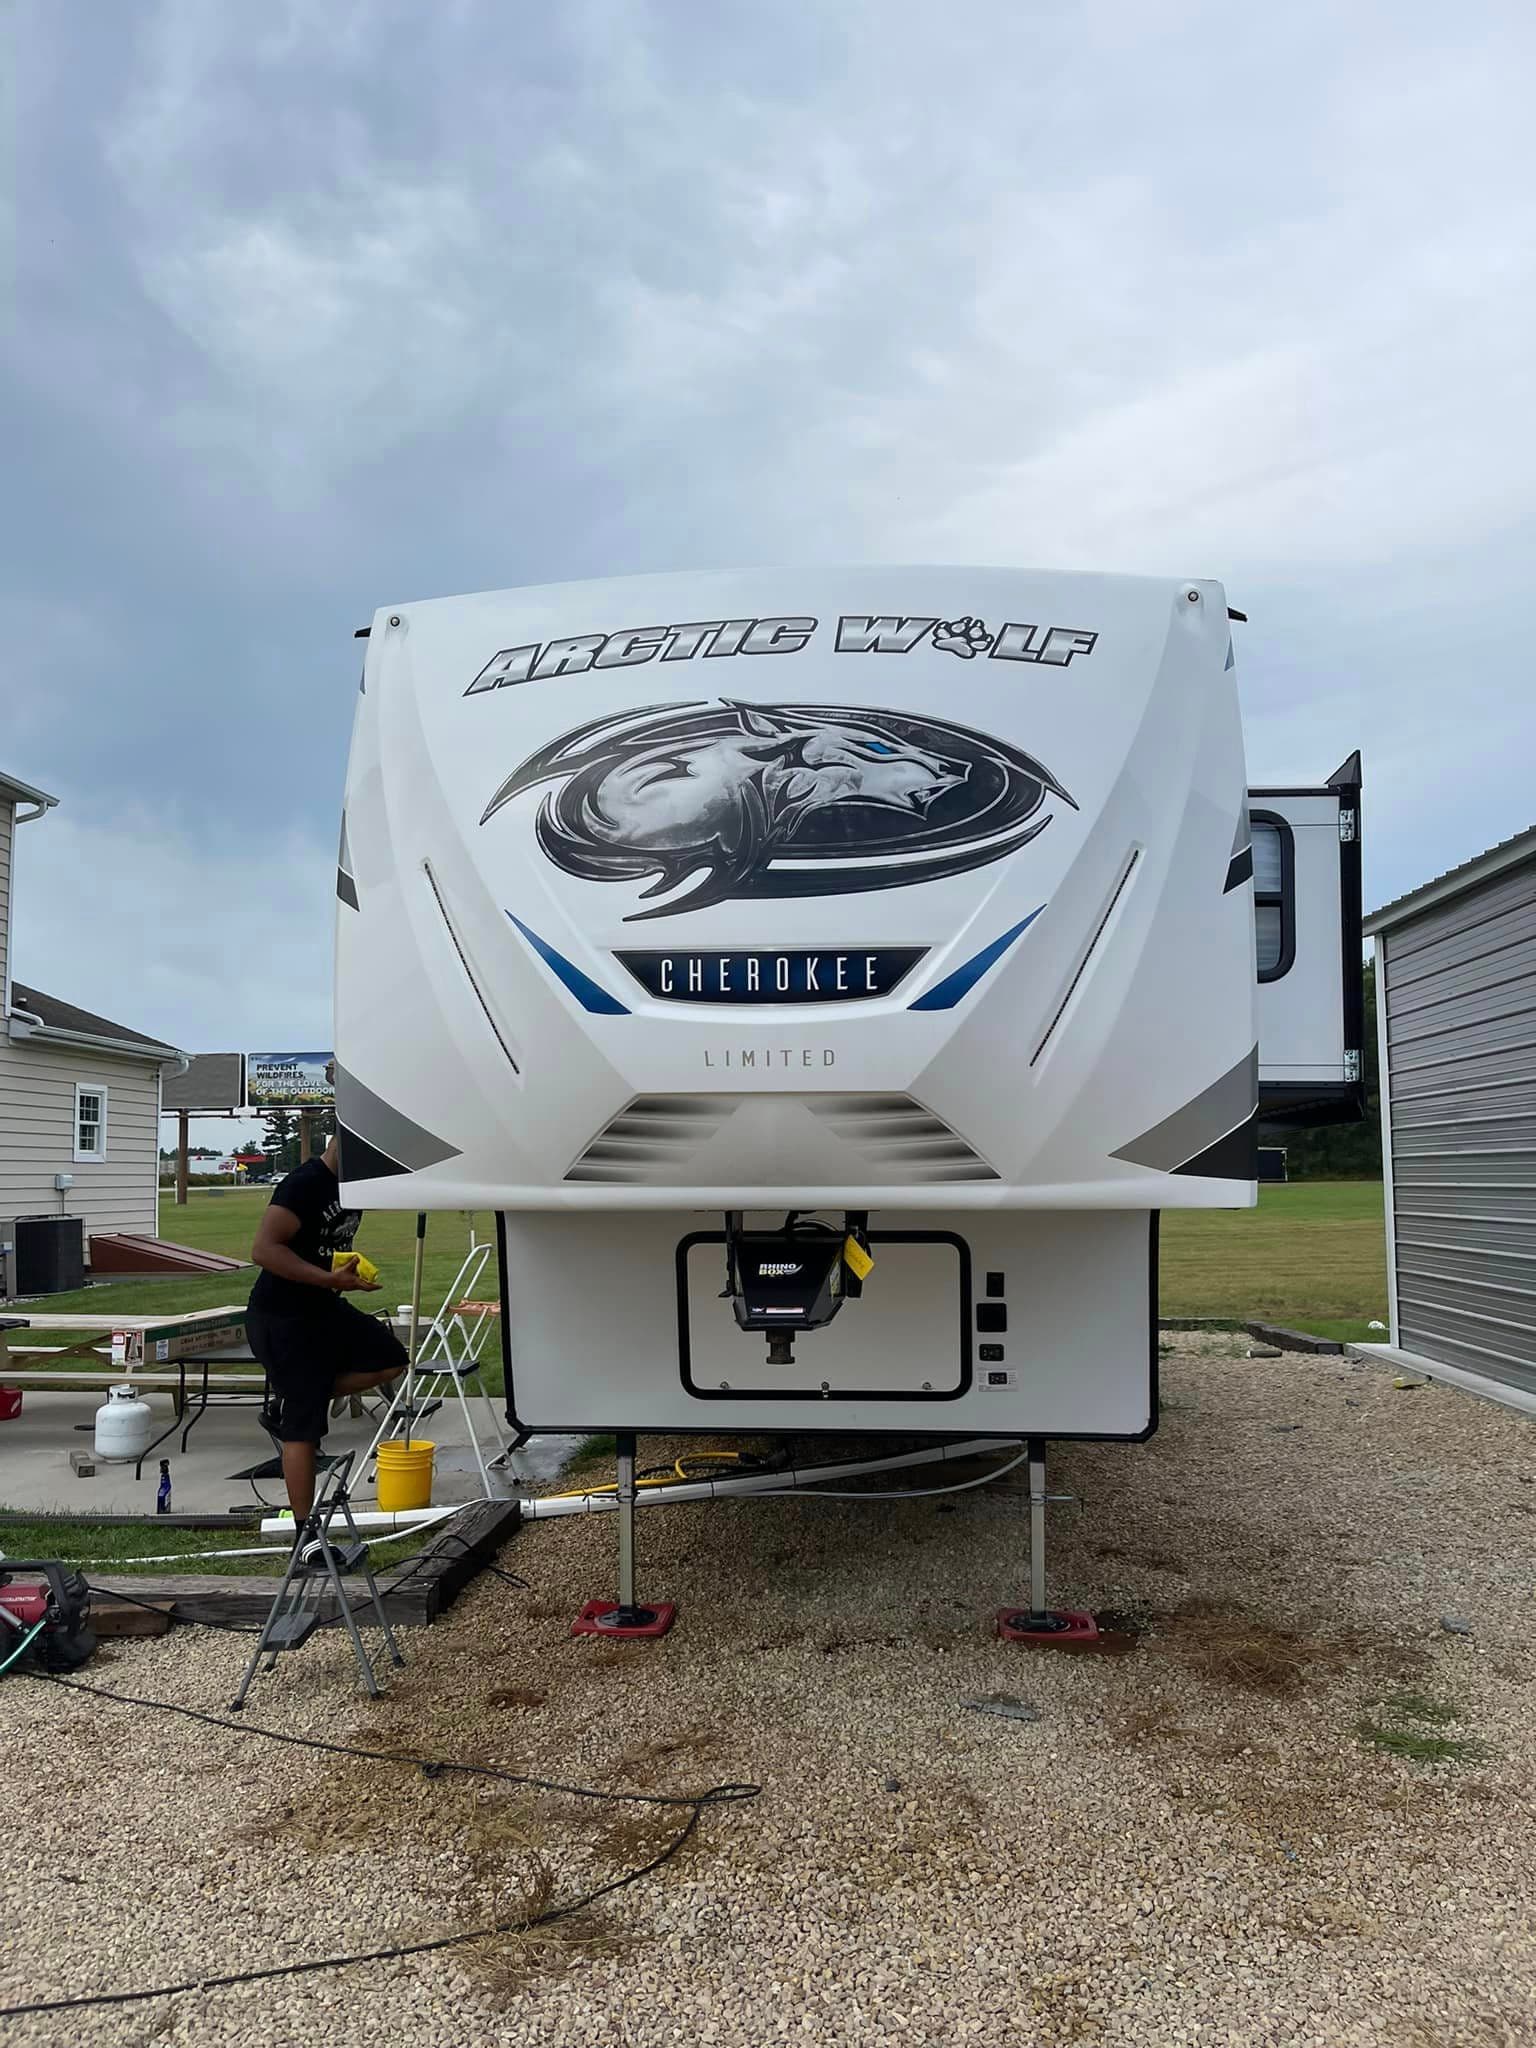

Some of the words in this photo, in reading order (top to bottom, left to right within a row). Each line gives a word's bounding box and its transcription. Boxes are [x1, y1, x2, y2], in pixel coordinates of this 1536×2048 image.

[462, 616, 818, 697] ARCTIC
[660, 956, 878, 992] CHEROKEE
[704, 1049, 835, 1067] LIMITED
[256, 1063, 298, 1071] PREVENT
[256, 1071, 306, 1080] WILDFIRES,
[256, 1080, 274, 1088] FOR
[279, 1079, 295, 1087] THE
[298, 1079, 321, 1087] LOVE
[256, 1087, 268, 1096] OF
[271, 1087, 288, 1095] THE
